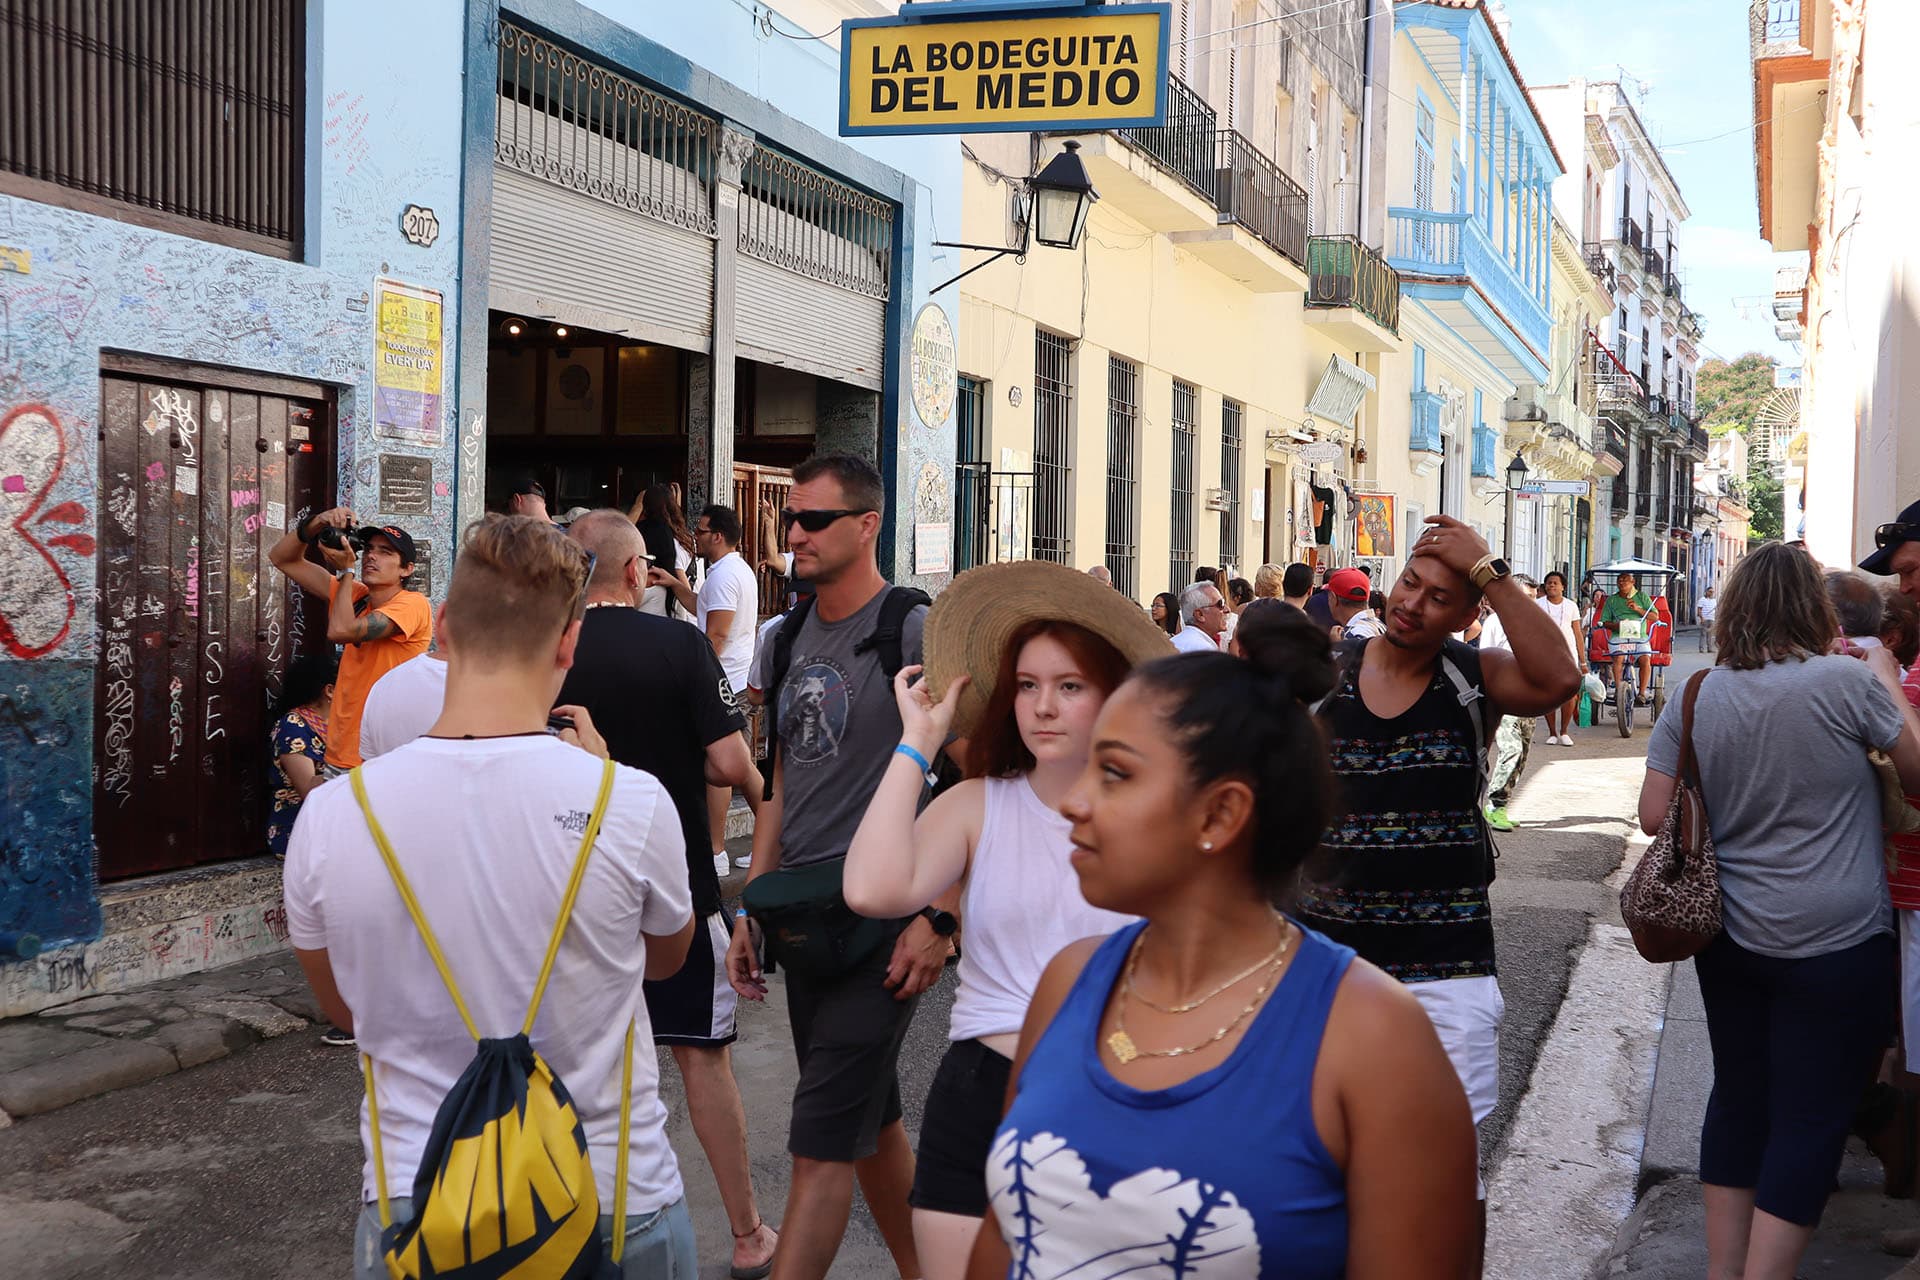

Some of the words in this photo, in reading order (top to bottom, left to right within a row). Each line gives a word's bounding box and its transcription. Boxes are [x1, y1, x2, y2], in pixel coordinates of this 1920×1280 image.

[871, 44, 914, 74] LA
[926, 34, 1139, 73] BODEGUITA
[870, 76, 958, 113] DEL
[975, 68, 1141, 110] MEDIO
[409, 214, 433, 240] 207
[385, 352, 414, 368] EVERY
[416, 358, 434, 371] DAY
[568, 810, 586, 819] THE
